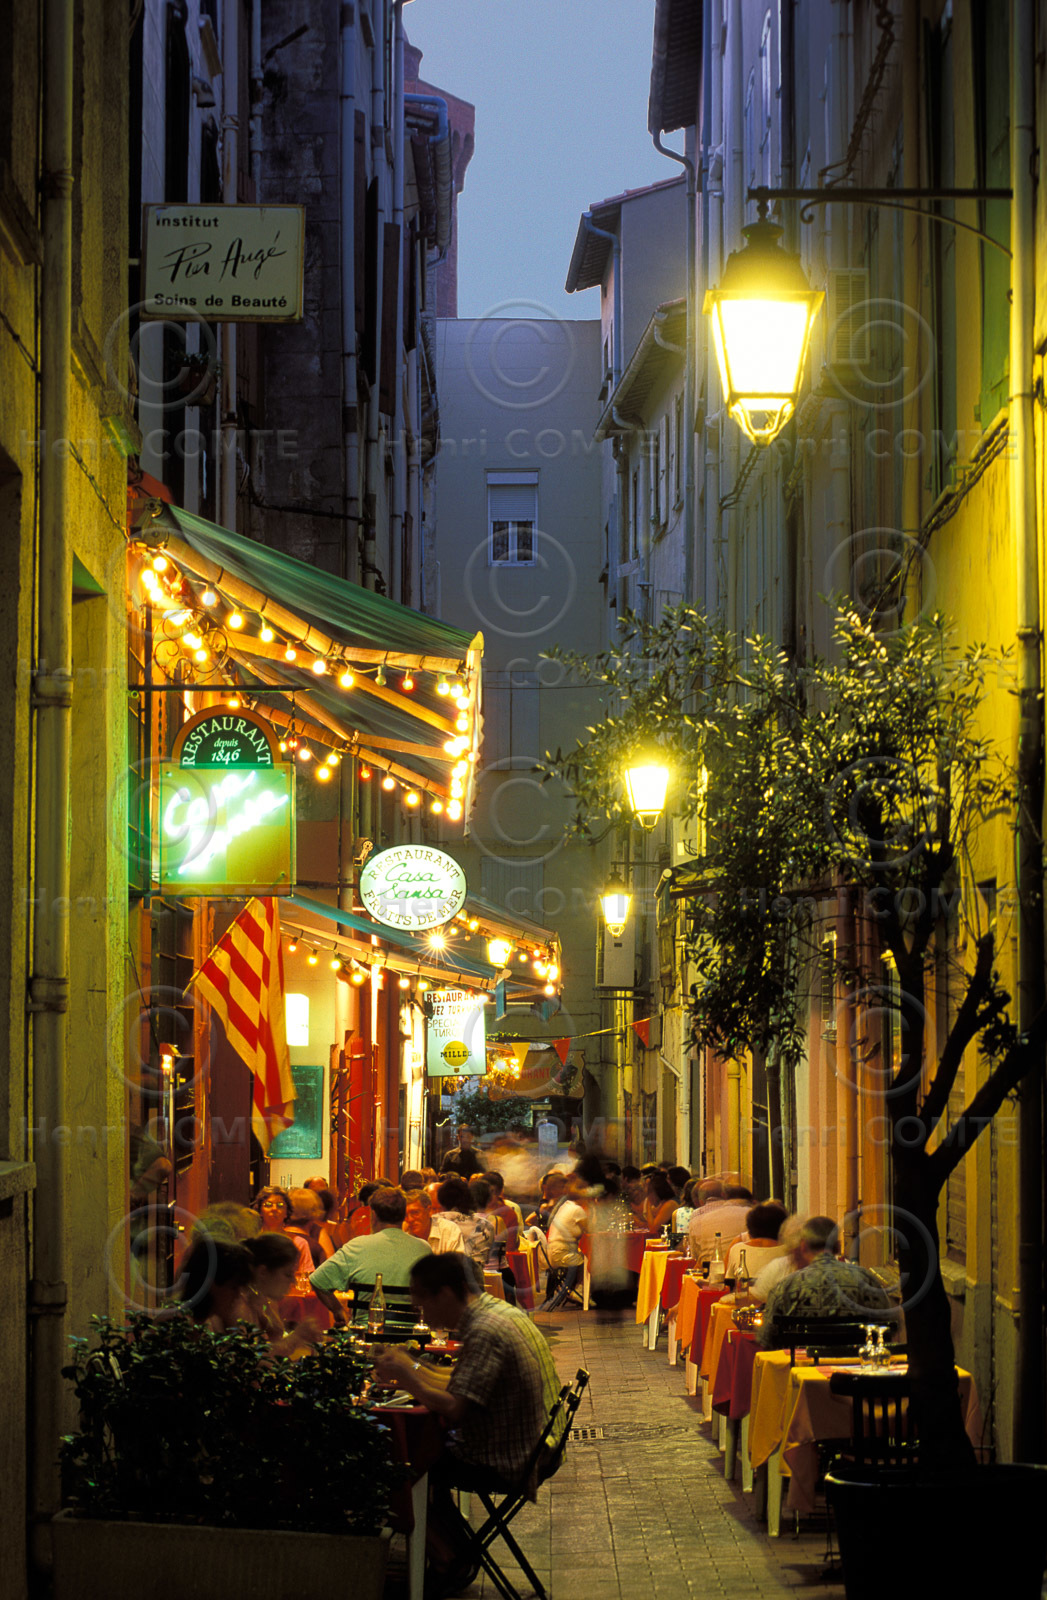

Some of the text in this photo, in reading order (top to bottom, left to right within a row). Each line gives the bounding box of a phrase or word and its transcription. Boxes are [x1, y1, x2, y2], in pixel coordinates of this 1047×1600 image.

[218, 230, 287, 283] Augé
[154, 293, 287, 308] Soins de Beauté
[182, 716, 271, 766] RESTAURANT
[213, 738, 239, 749] depuis
[211, 748, 241, 765] 1846
[367, 849, 460, 880] RESTAURANT
[385, 862, 441, 883] Casa
[376, 882, 449, 900] Sansa
[363, 889, 463, 926] FRUITS DE MER
